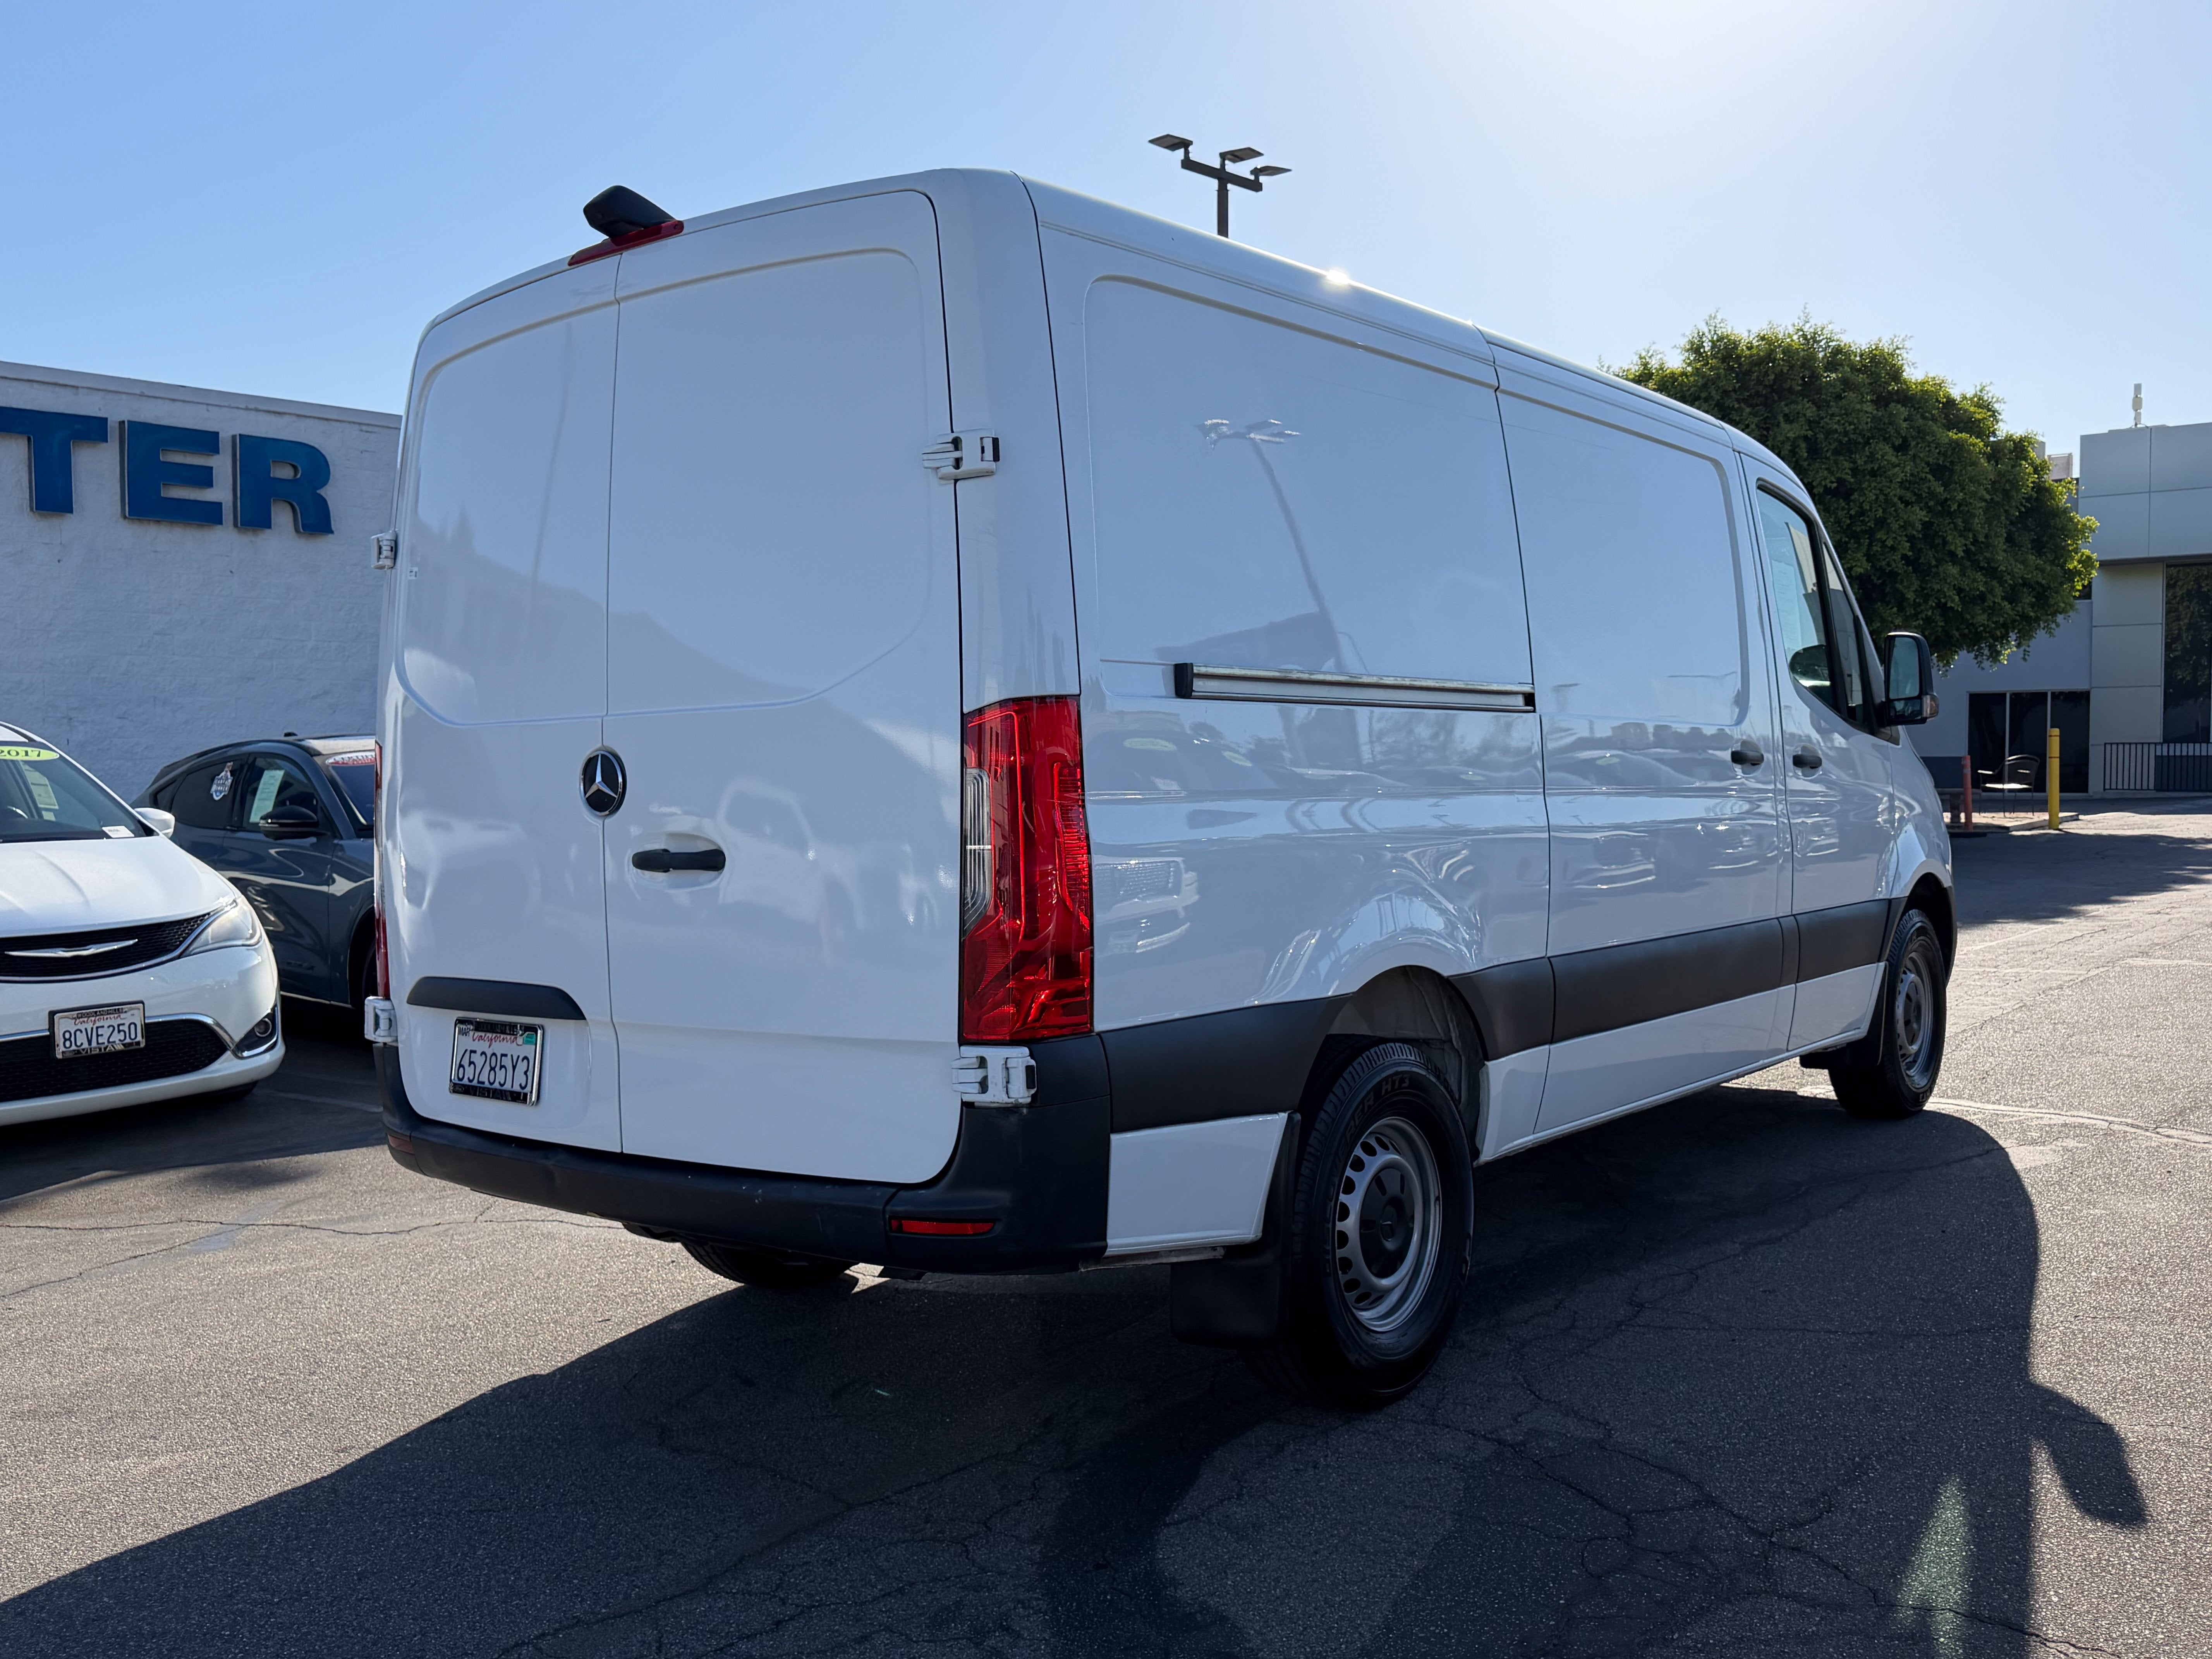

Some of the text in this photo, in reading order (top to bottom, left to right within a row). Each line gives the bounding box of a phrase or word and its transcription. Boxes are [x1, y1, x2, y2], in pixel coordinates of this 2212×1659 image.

[0, 406, 334, 534] TER
[62, 1022, 137, 1049] 8CVE250
[457, 1048, 530, 1090] 65285Y3
[1381, 1074, 1410, 1096] HT3
